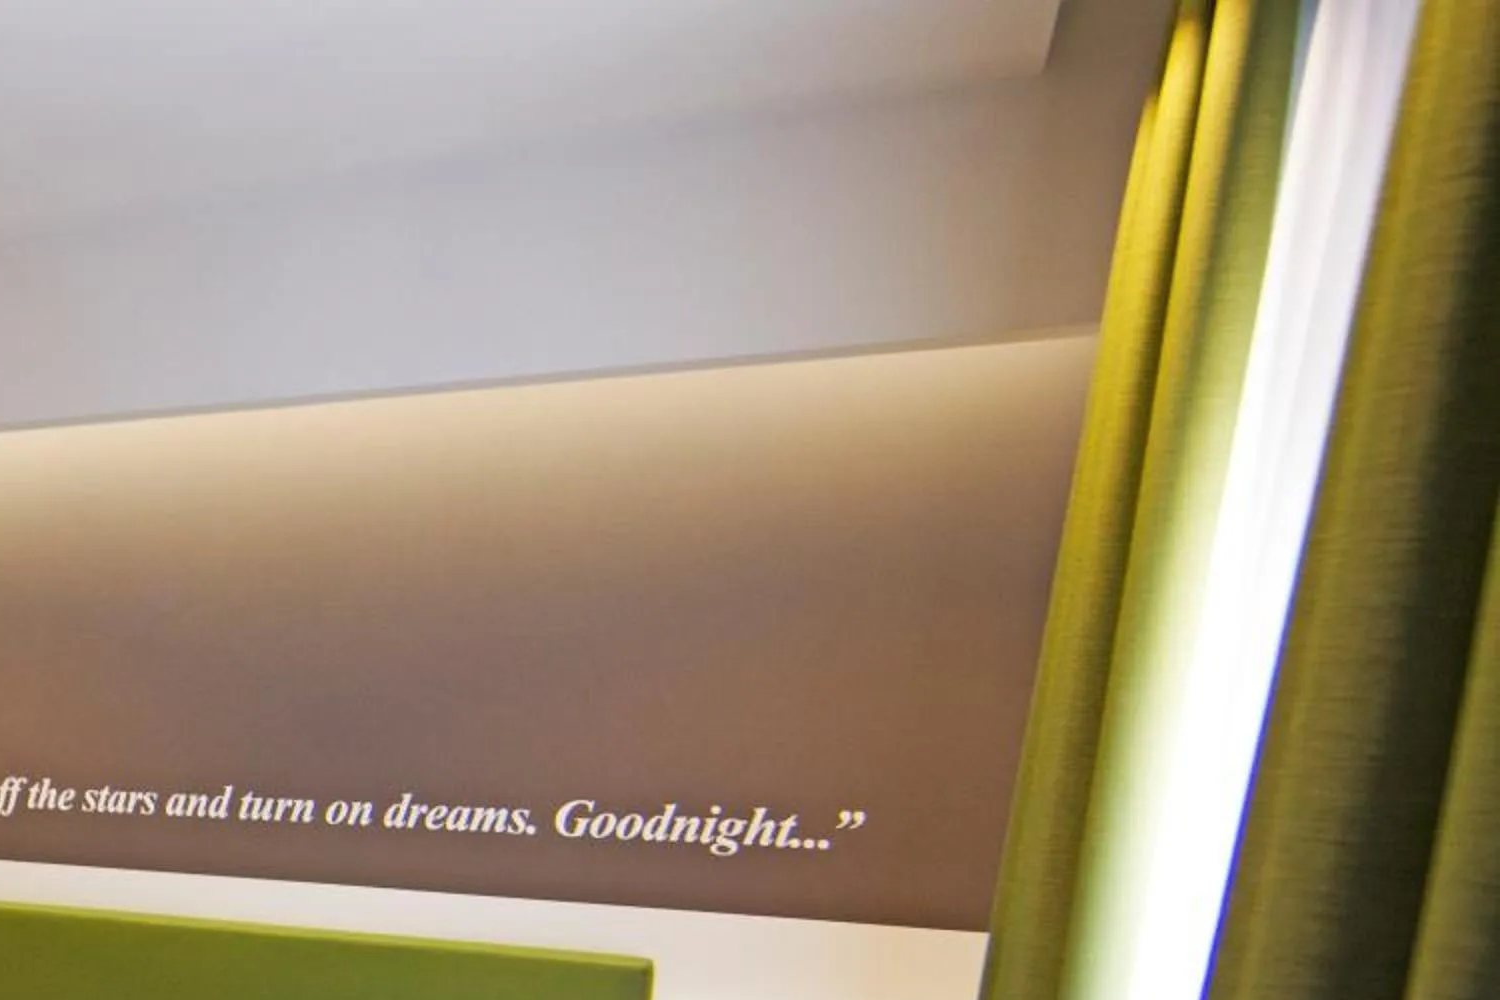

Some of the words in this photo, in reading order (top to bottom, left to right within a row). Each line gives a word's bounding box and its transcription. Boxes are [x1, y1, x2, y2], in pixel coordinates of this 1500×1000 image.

[27, 777, 77, 811] the
[81, 785, 158, 816] stars
[165, 784, 235, 820] and
[238, 791, 316, 824] turn
[324, 800, 374, 827] on
[382, 792, 538, 837] dreams.
